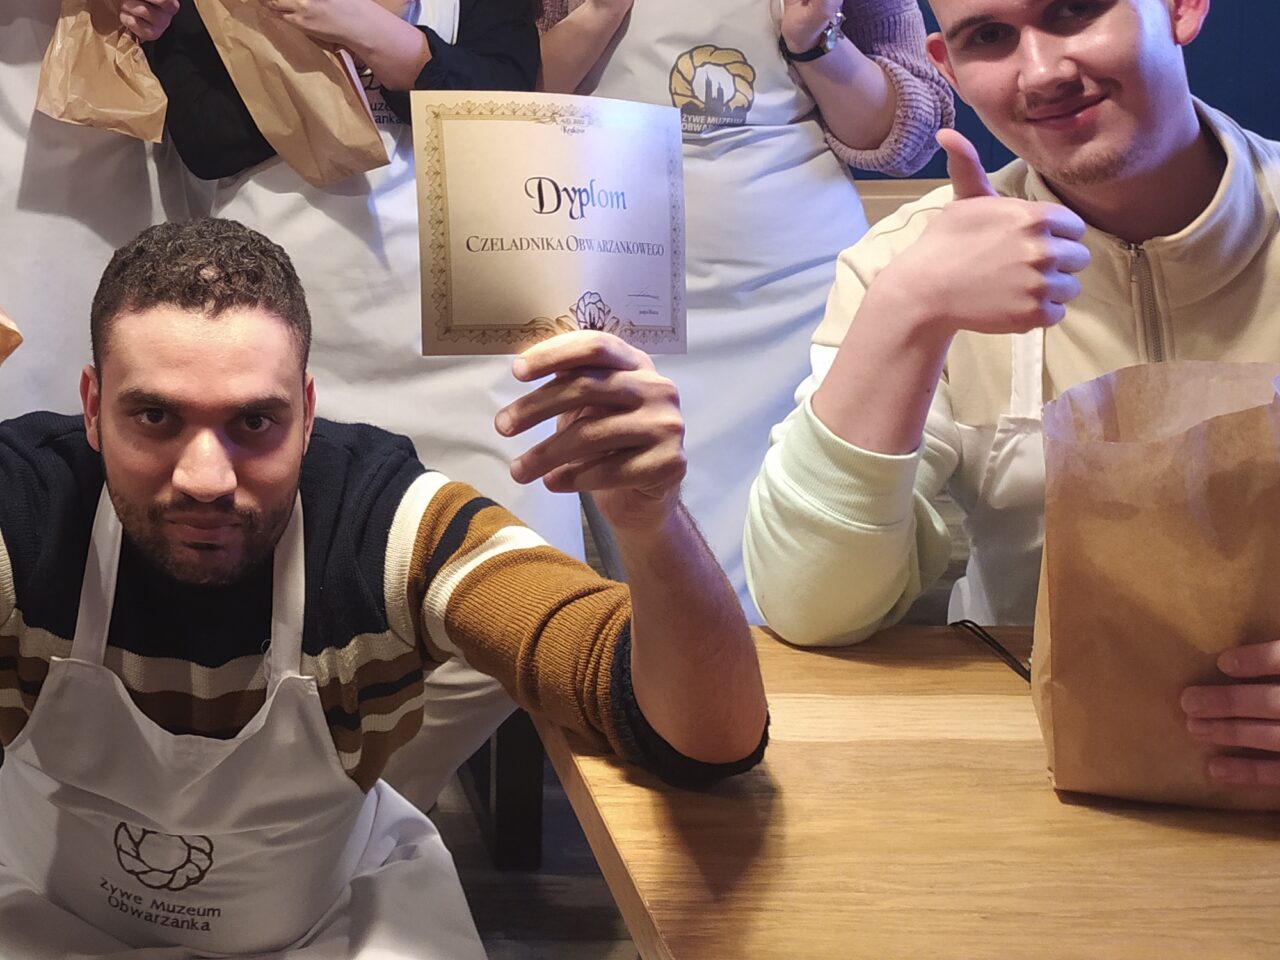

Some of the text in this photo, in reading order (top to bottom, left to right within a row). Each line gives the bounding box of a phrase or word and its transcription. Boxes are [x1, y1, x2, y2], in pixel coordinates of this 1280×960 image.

[524, 176, 628, 220] Dyplom
[466, 235, 665, 257] CZELADNIKA OBWARZANKOWEGO
[107, 895, 211, 932] Obwarzanka
[150, 899, 222, 918] Muzeum
